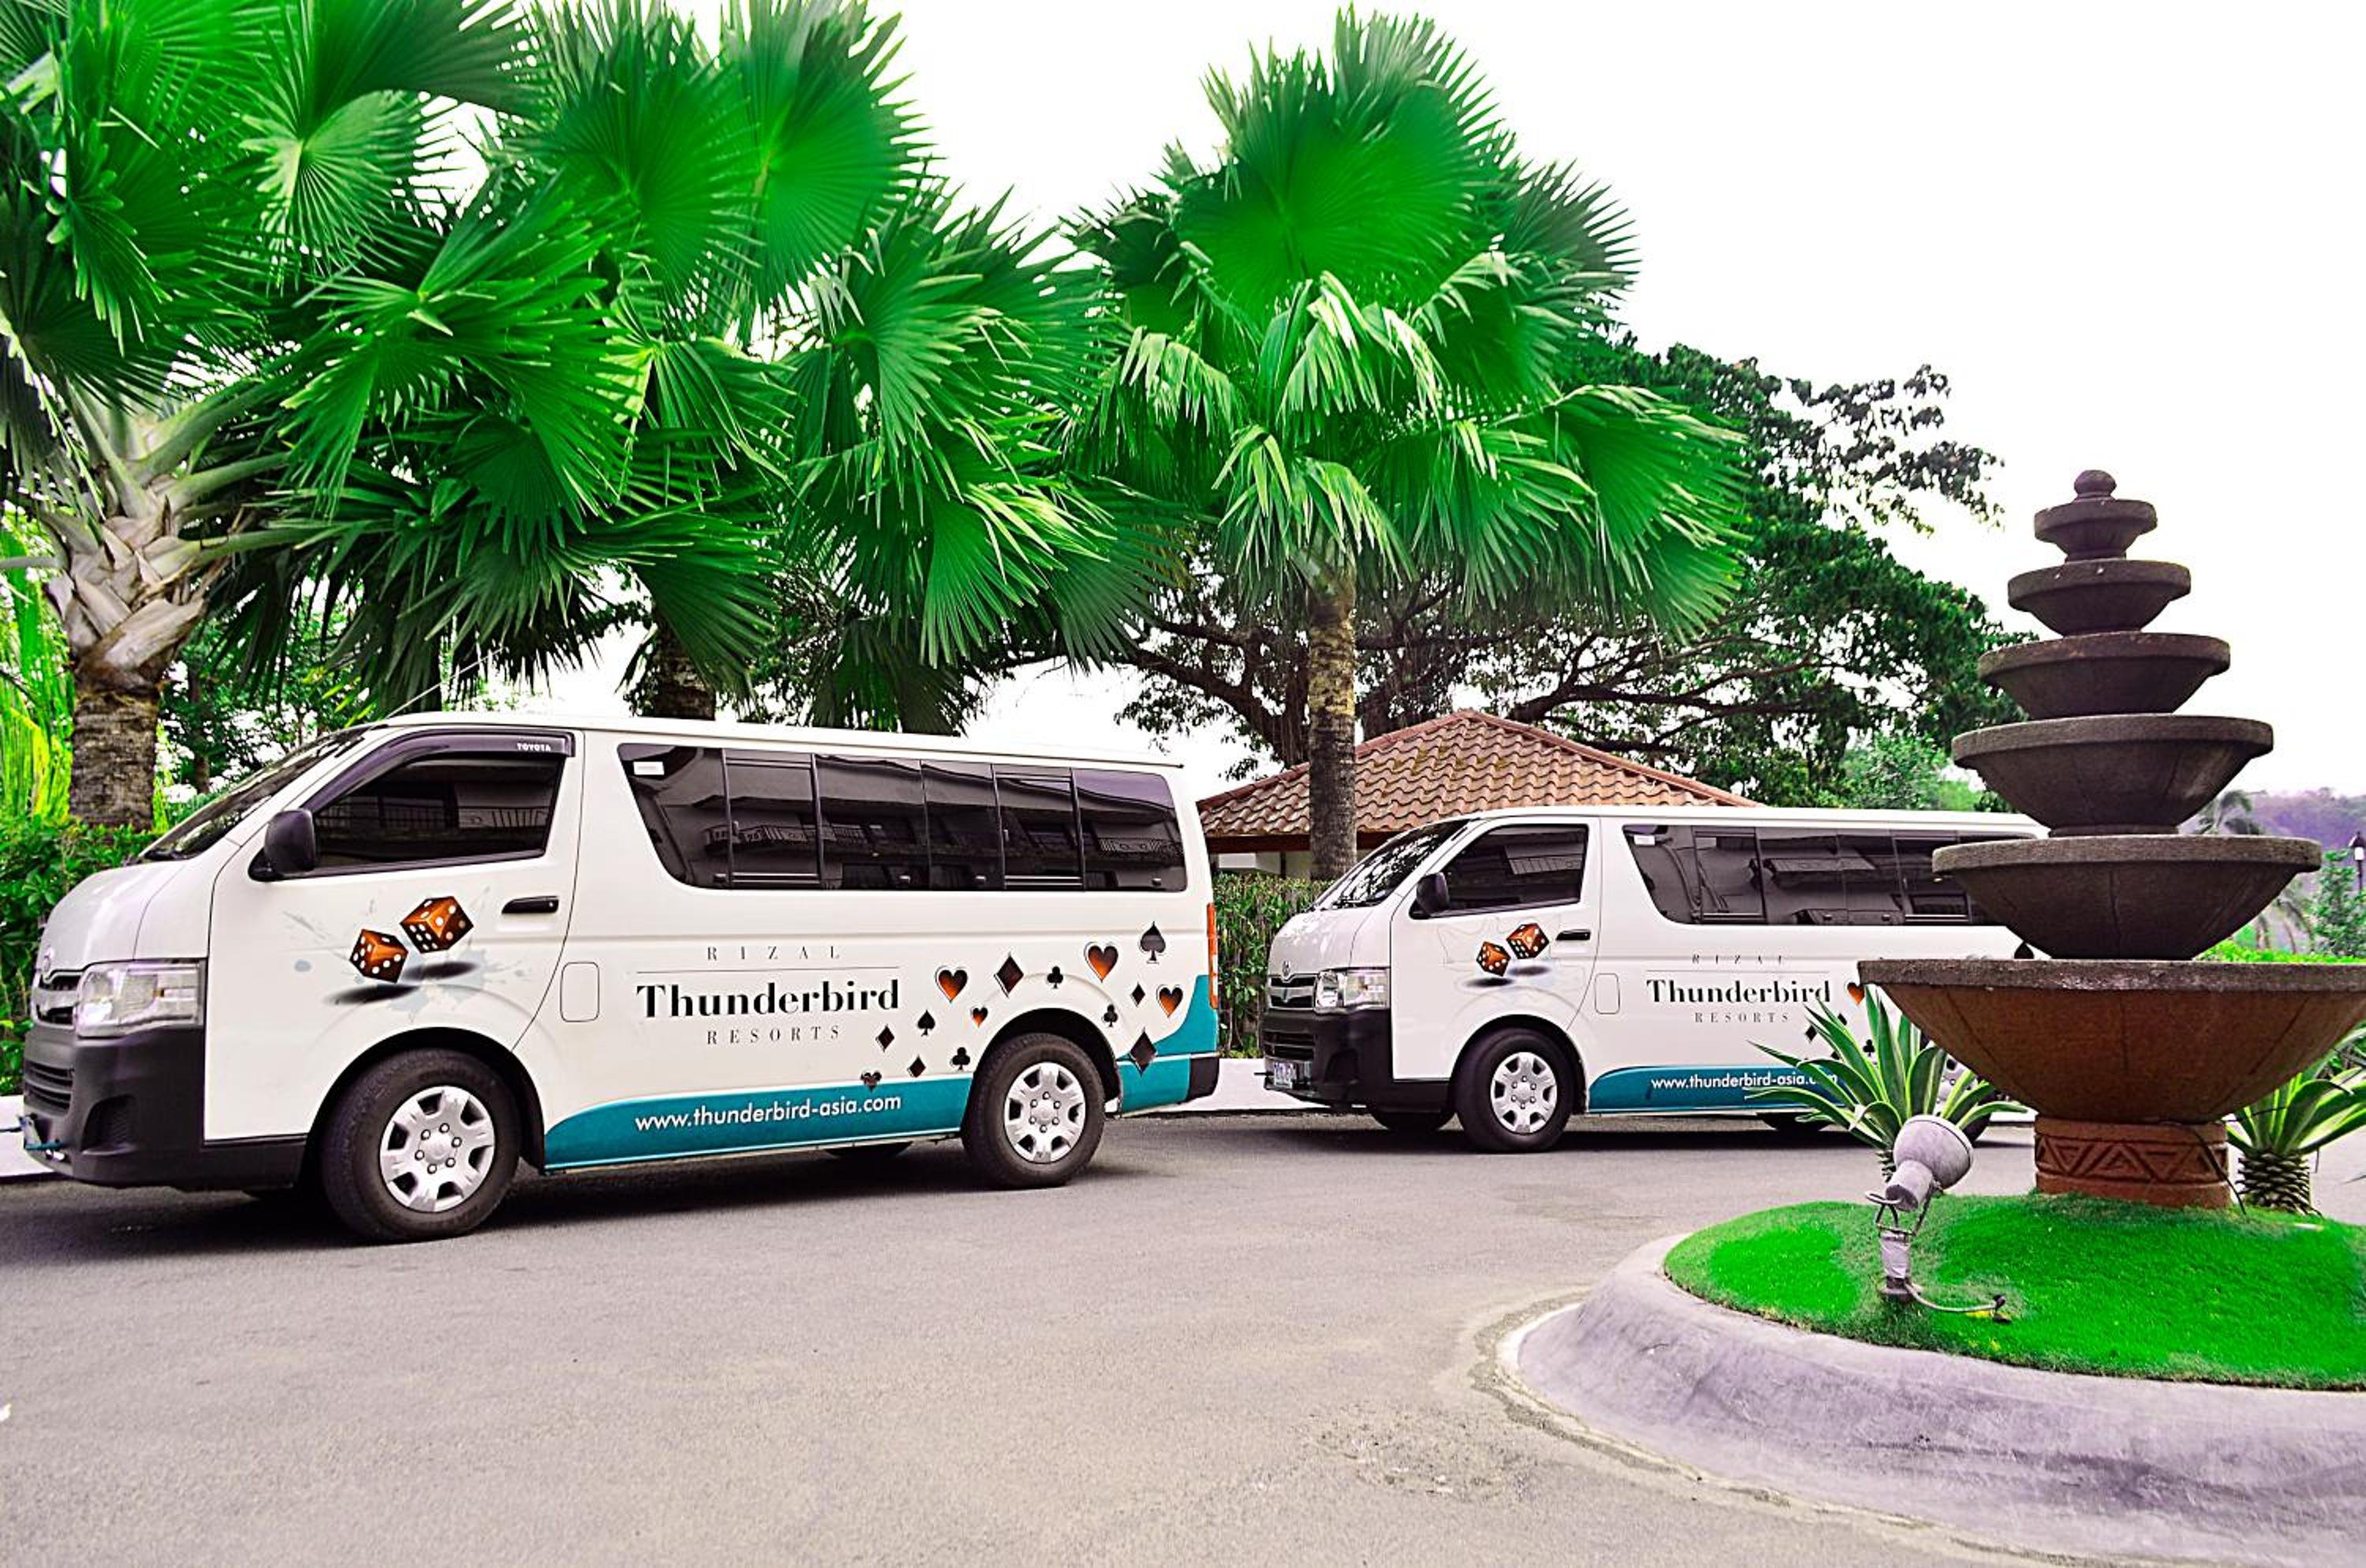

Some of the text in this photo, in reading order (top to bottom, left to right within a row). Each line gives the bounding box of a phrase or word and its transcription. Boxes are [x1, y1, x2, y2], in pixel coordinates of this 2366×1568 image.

[517, 742, 551, 752] TOYOTA
[707, 946, 840, 961] RIZAL
[636, 979, 899, 1018] Thunderbird
[1646, 980, 1830, 1003] Thunderbird
[1695, 1012, 1789, 1023] RESORTS
[707, 1025, 839, 1044] RESORTS
[1651, 1070, 1838, 1088] www.thunderbird-asia.c
[635, 1096, 901, 1130] www.thunderbird-asia.com
